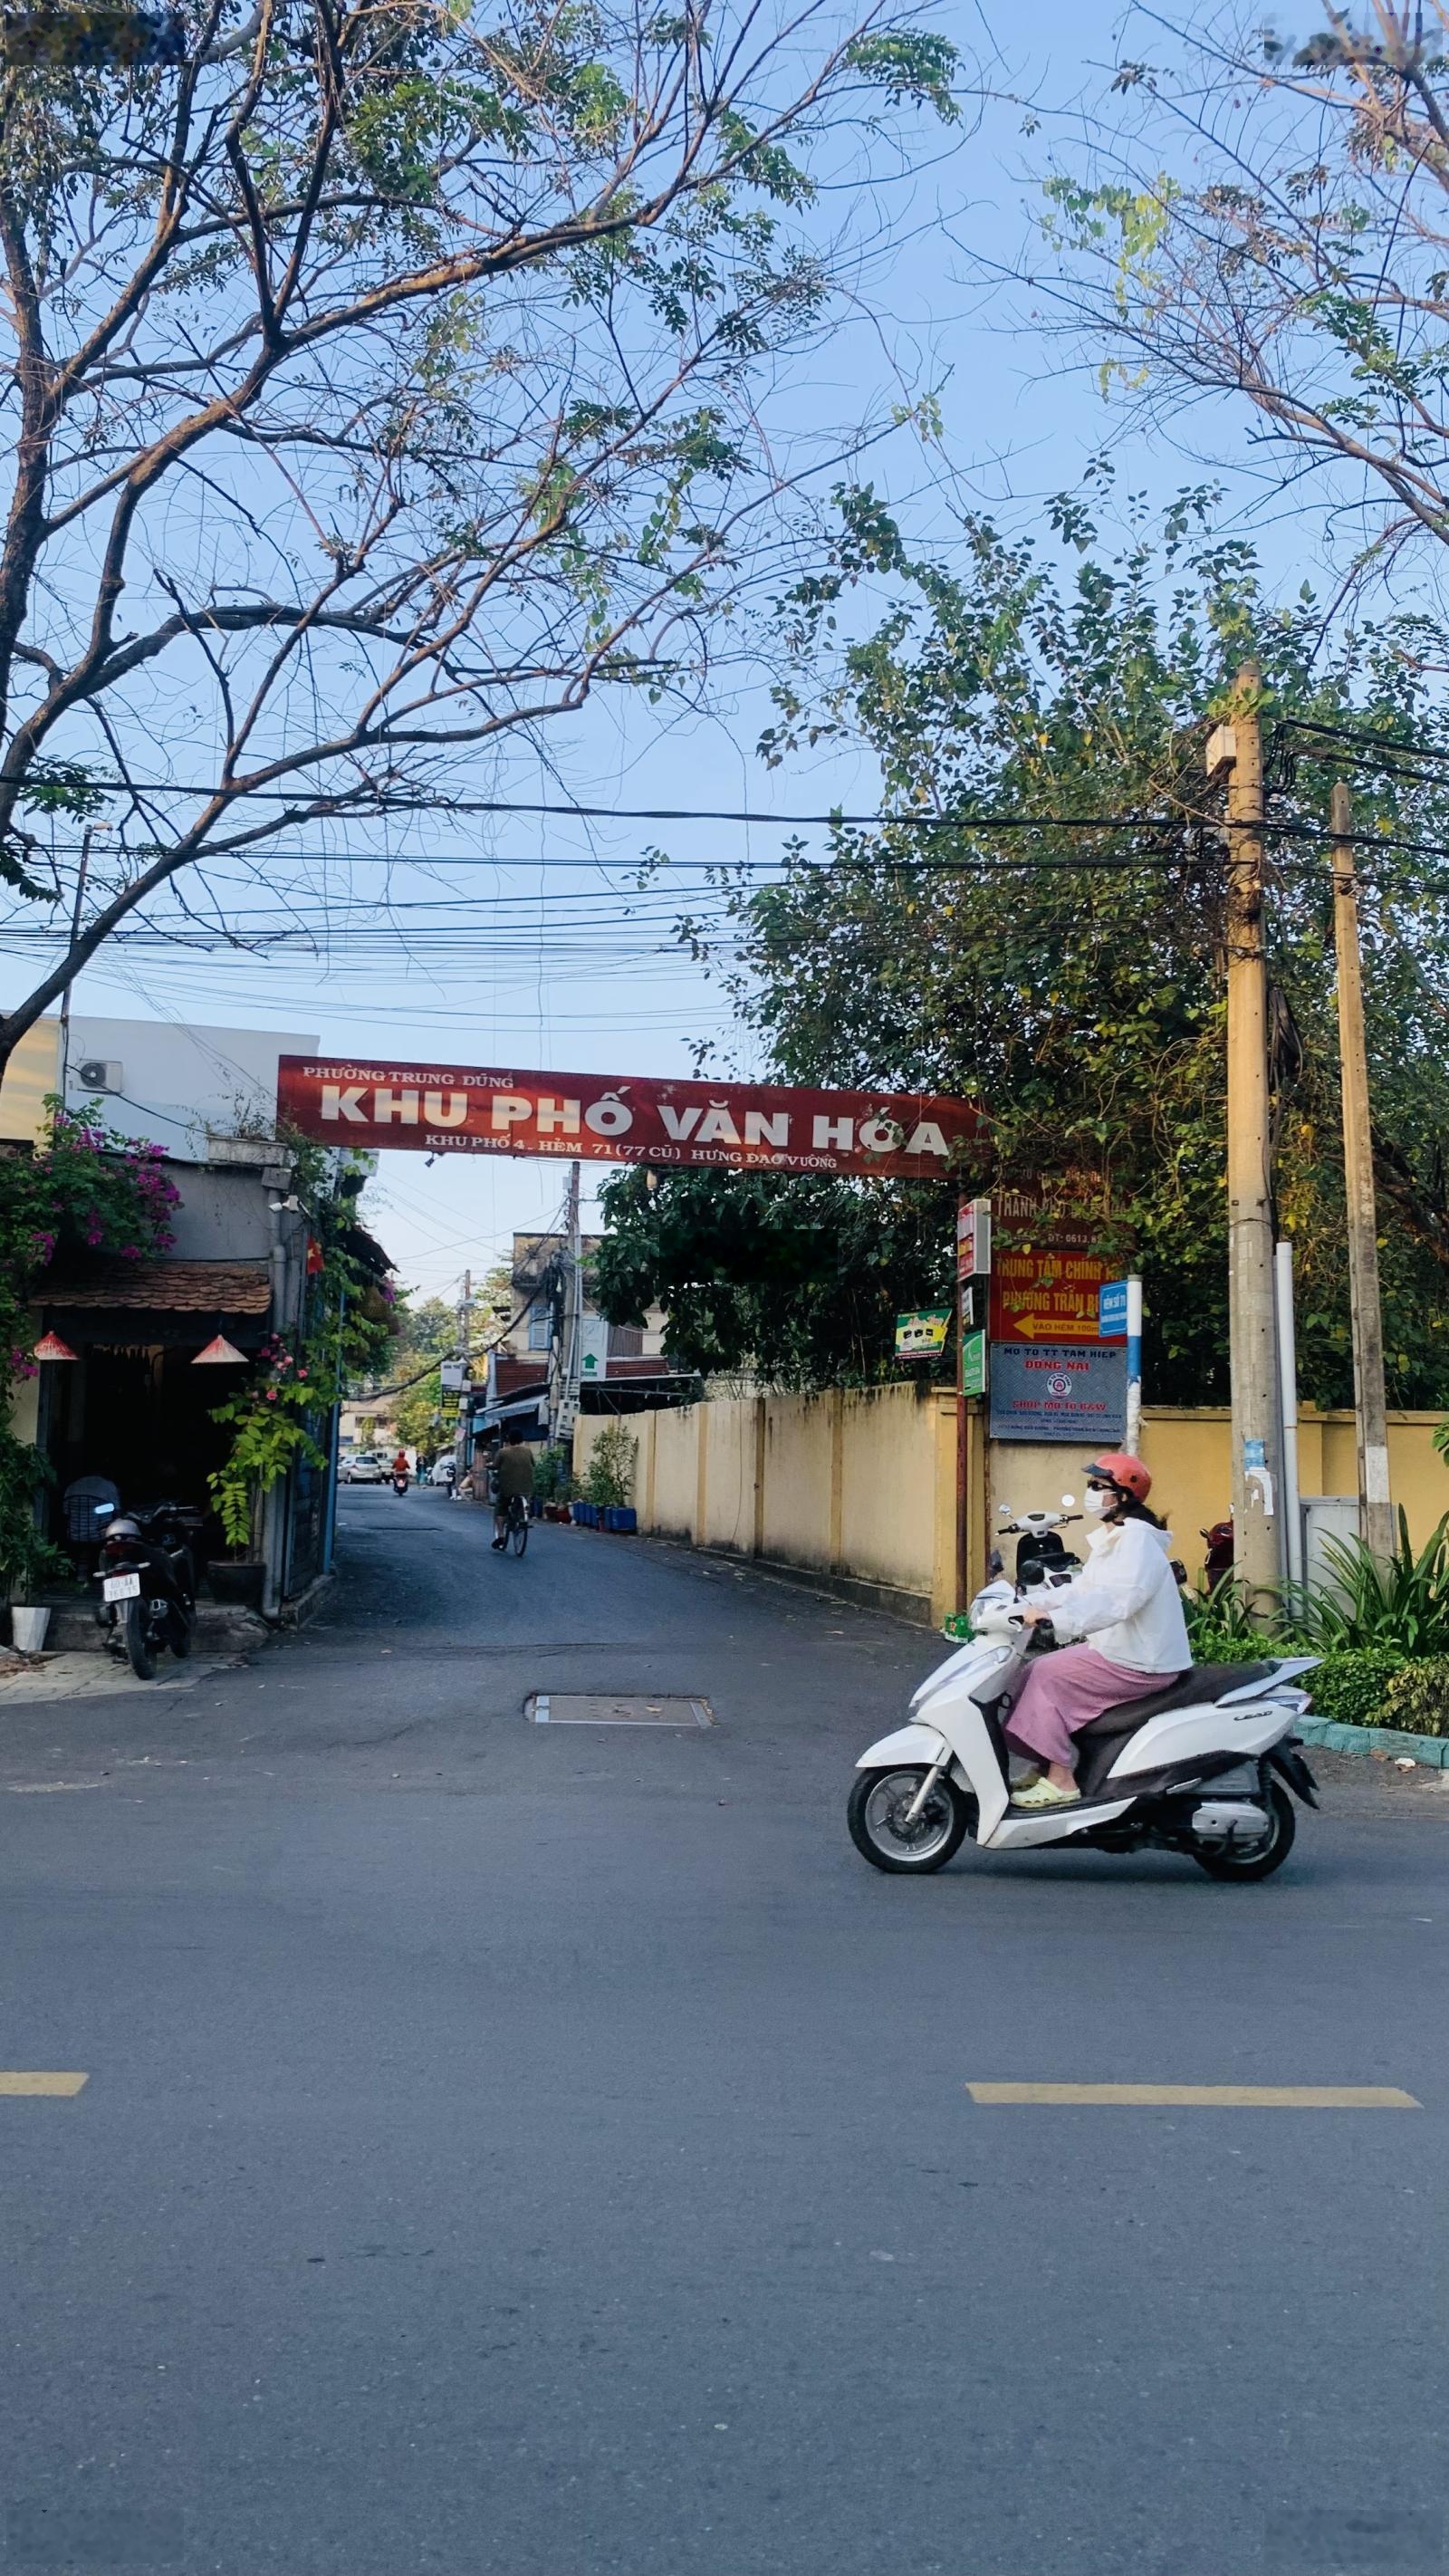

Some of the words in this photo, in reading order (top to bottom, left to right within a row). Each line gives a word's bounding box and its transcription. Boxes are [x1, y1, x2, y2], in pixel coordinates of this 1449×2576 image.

[302, 1064, 386, 1081] PHƯỜNG
[389, 1072, 455, 1085] TRUNG
[321, 1085, 468, 1128] KHU
[492, 1086, 633, 1136] PHỐ
[657, 1100, 789, 1147] VĂN
[425, 1135, 466, 1147] KHU
[471, 1133, 511, 1149] PHỐ
[513, 1139, 524, 1150] 4
[538, 1138, 582, 1153] HẺM
[690, 1149, 743, 1163] HƯNG
[996, 1258, 1033, 1277] TRUNG
